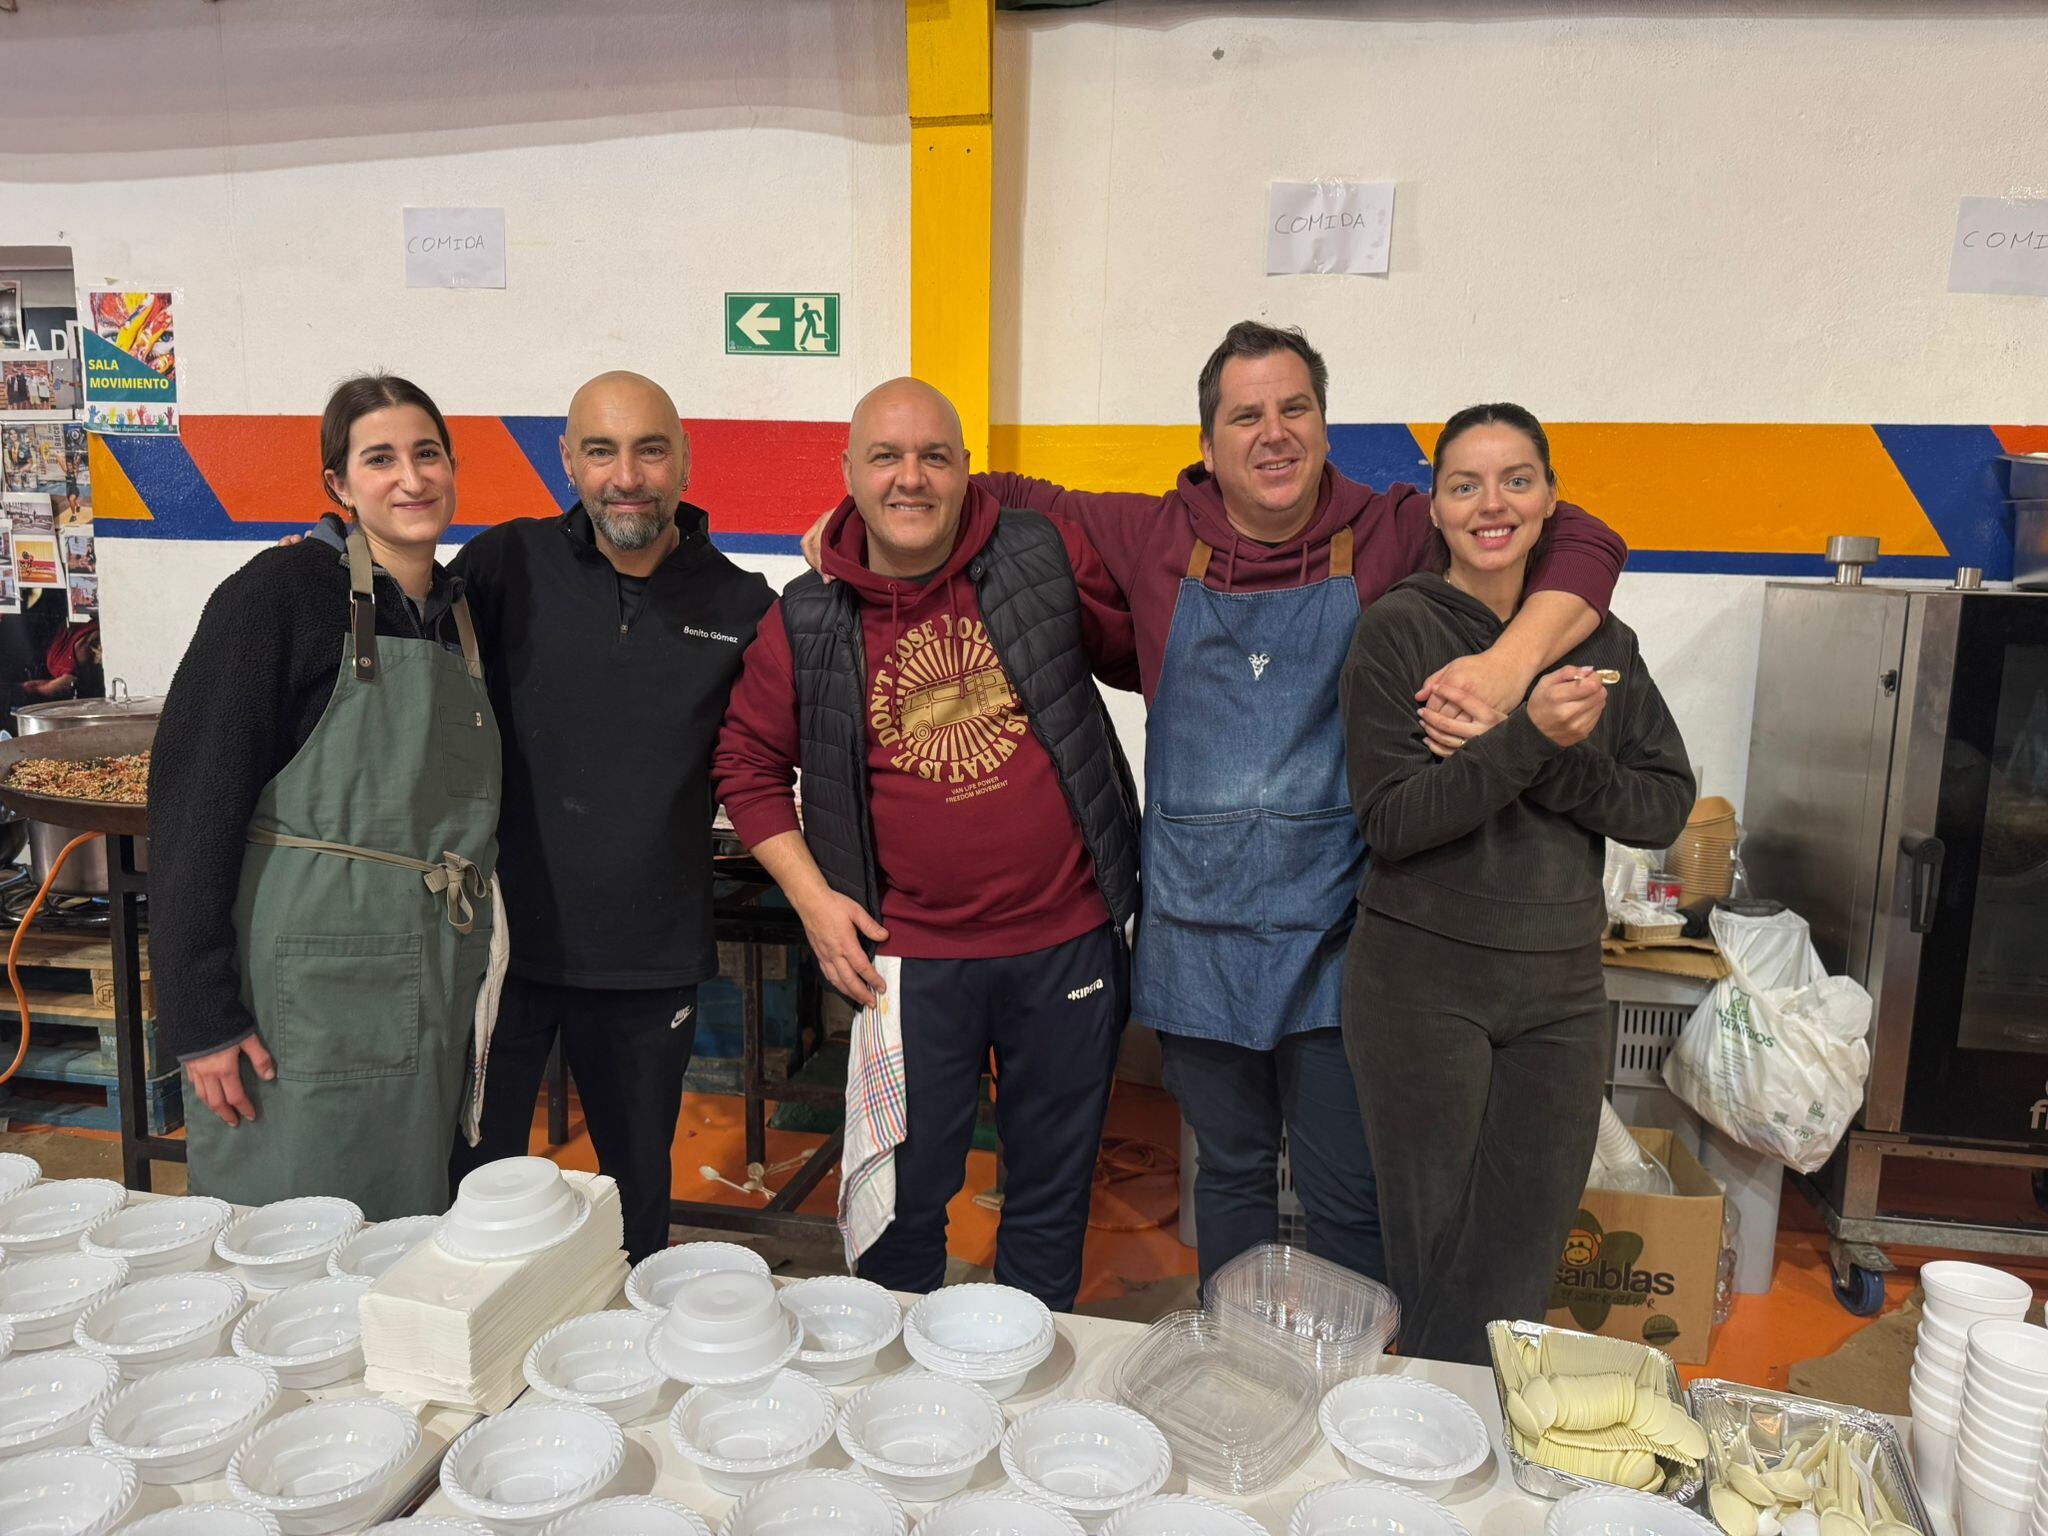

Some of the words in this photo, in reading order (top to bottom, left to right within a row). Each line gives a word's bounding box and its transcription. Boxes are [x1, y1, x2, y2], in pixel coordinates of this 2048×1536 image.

[1274, 212, 1365, 235] COMIDA
[407, 234, 485, 254] COMIDA
[88, 359, 119, 370] SALA
[89, 377, 169, 389] MOVIMIENTO
[683, 625, 709, 638] Benito
[710, 631, 739, 643] Gómez
[869, 669, 901, 748] DON'T
[890, 750, 919, 772] IT
[917, 759, 943, 783] IS
[948, 736, 1018, 784] WHAT
[945, 790, 975, 804] FREEDOM
[975, 780, 1009, 796] MOVEMENT
[951, 786, 964, 796] VAN
[964, 783, 977, 792] LIFE
[977, 776, 999, 788] POWER
